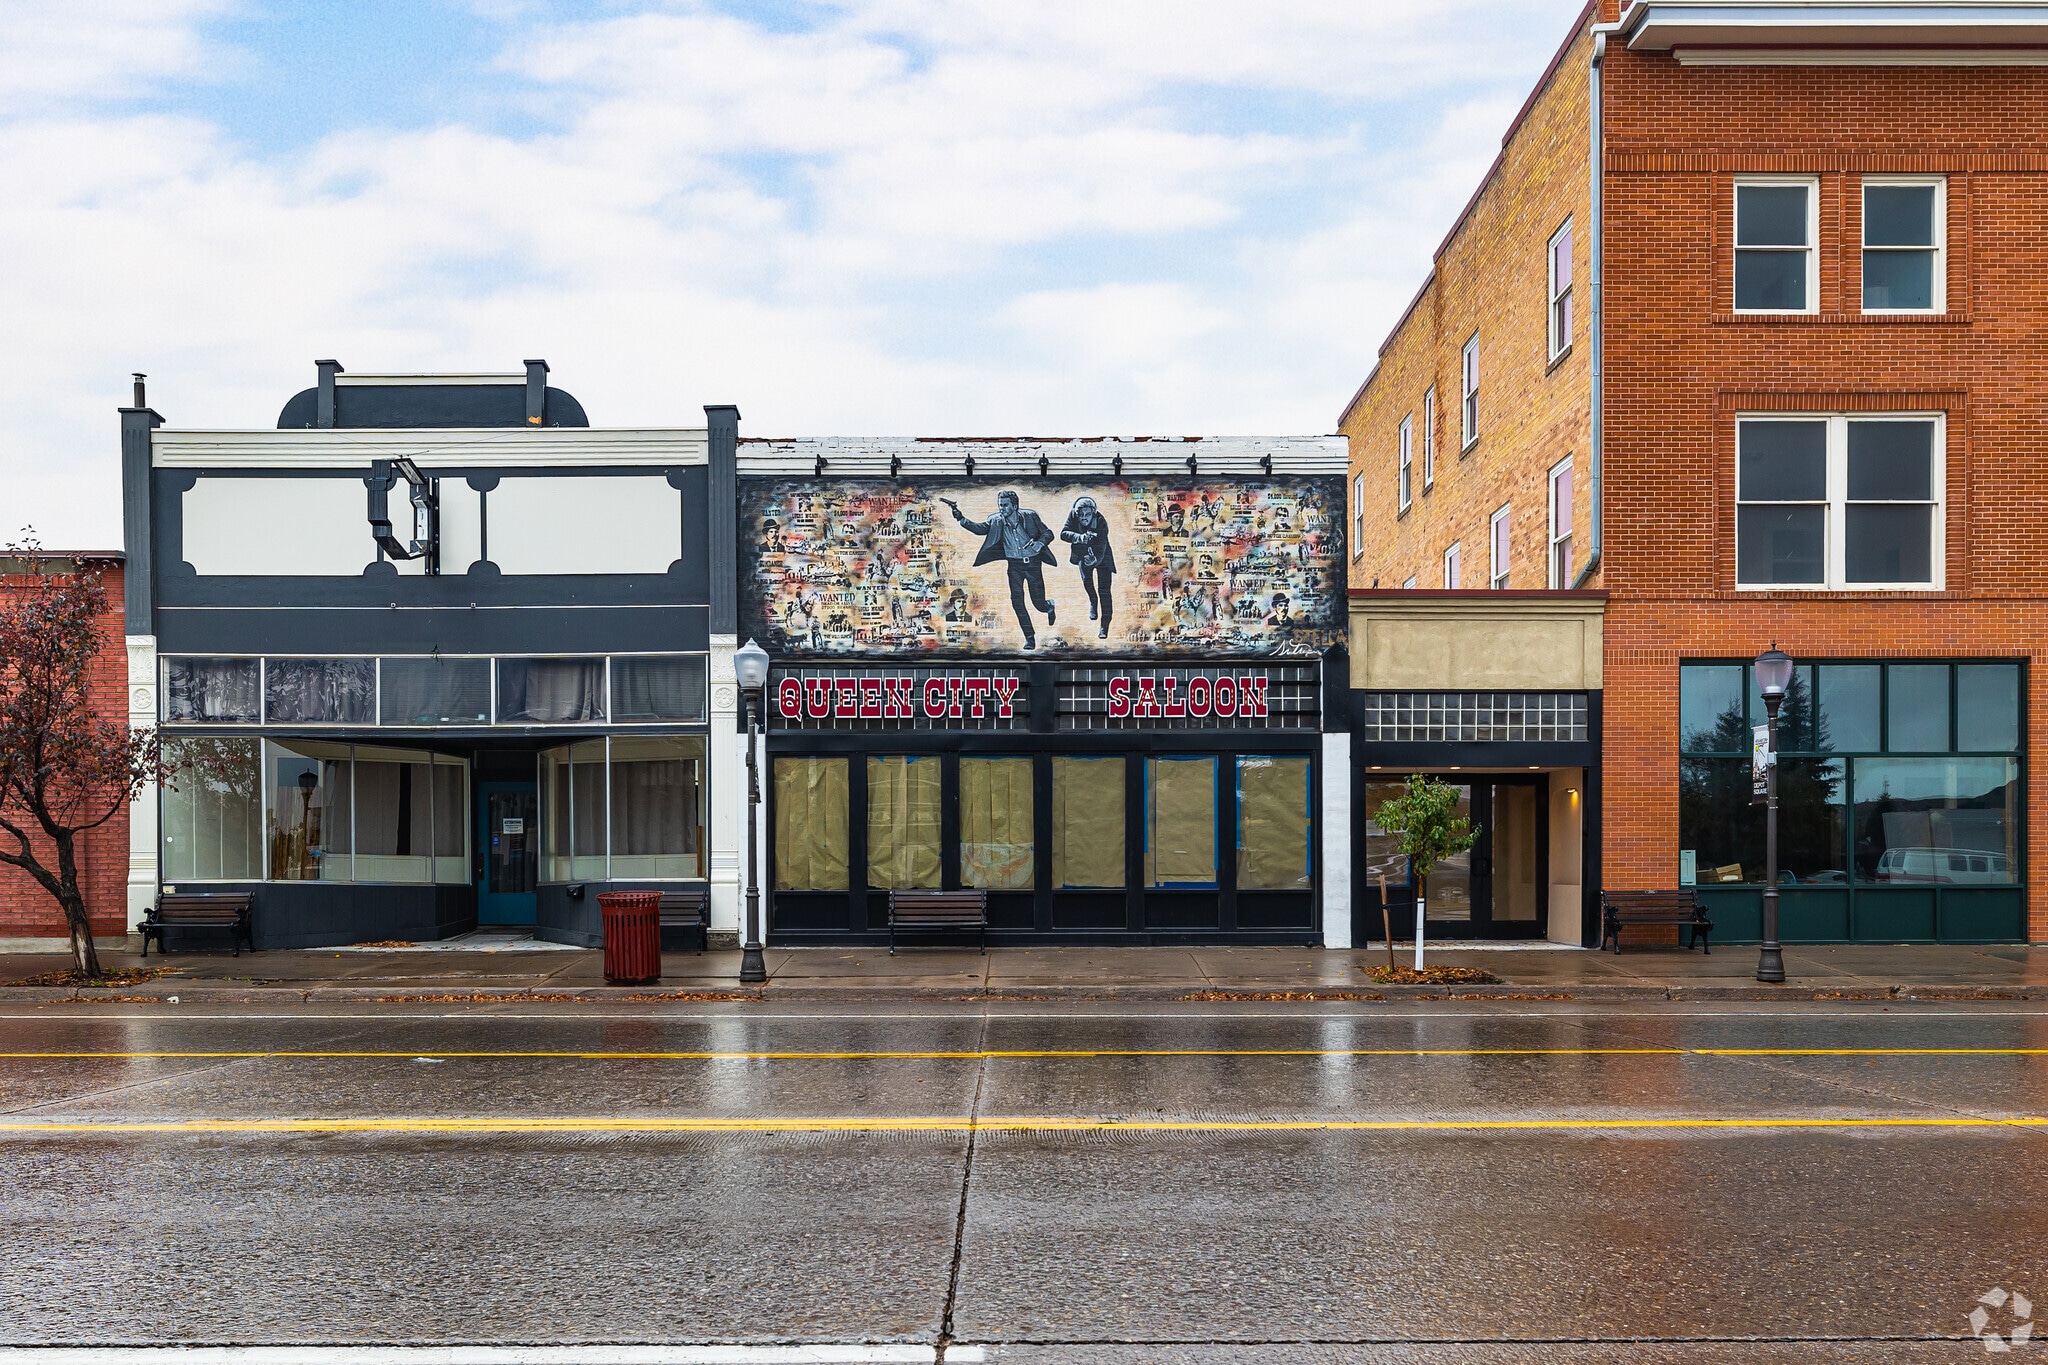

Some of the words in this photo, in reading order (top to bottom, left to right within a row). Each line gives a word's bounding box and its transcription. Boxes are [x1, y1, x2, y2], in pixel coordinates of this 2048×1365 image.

[819, 592, 855, 601] WANTED
[1294, 628, 1348, 646] STELLA
[778, 676, 913, 721] QUEEN
[923, 677, 1019, 718] CITY
[1108, 676, 1269, 718] SALOON
